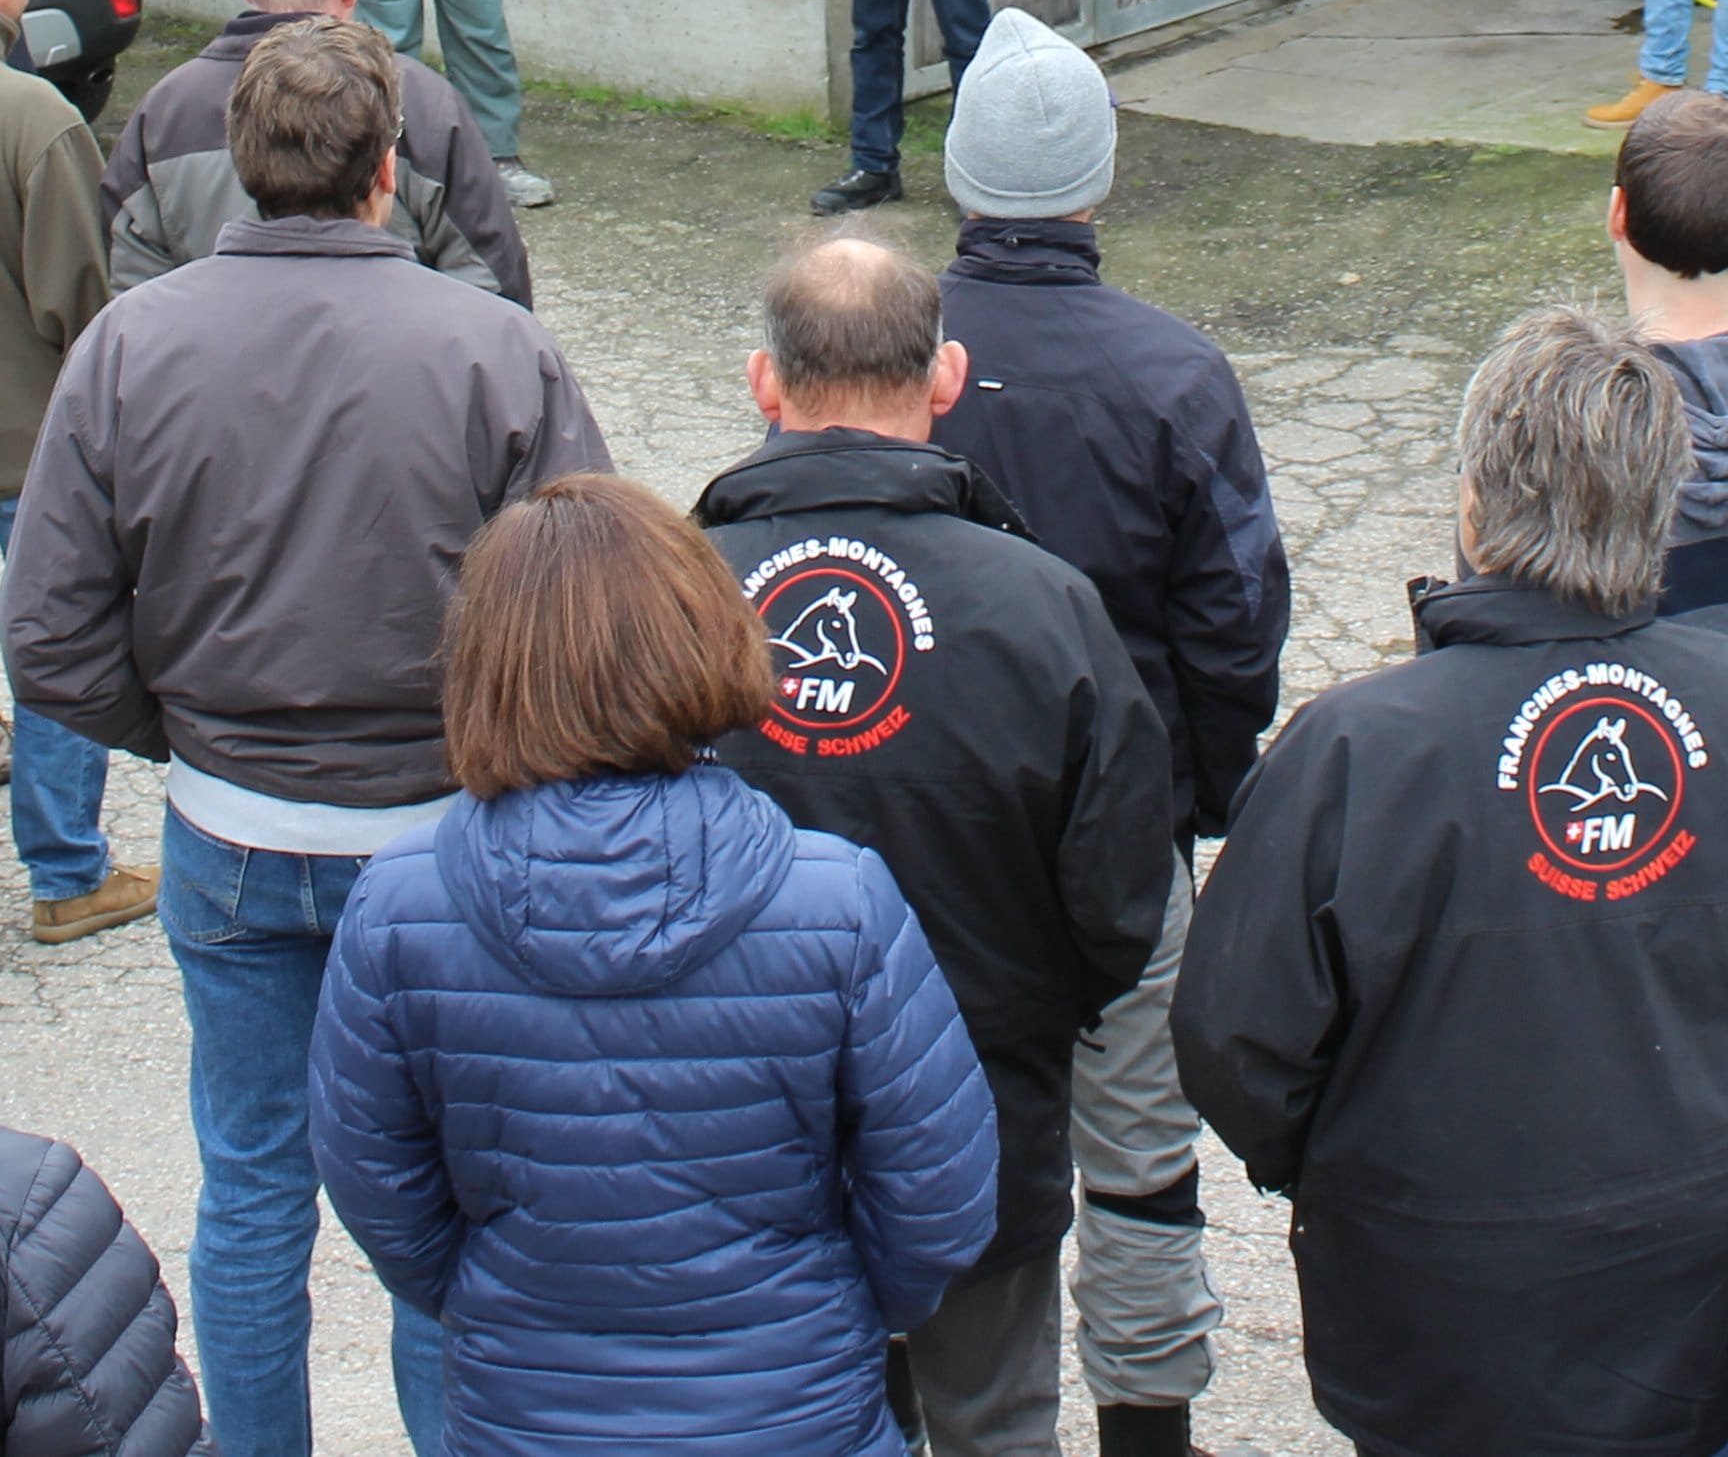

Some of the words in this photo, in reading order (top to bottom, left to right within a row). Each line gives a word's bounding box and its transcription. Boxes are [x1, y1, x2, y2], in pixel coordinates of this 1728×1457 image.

[741, 537, 935, 651] NCHES-MONTAGNES
[795, 678, 855, 714] FM
[1497, 663, 1709, 790] FRANCHES-MONTAGNES
[762, 718, 809, 755] ISSE
[816, 704, 911, 756] SCHWEIZ
[1580, 813, 1636, 854] FM
[1527, 852, 1597, 899] SUISSE
[1605, 829, 1697, 900] SCHWEIZ
